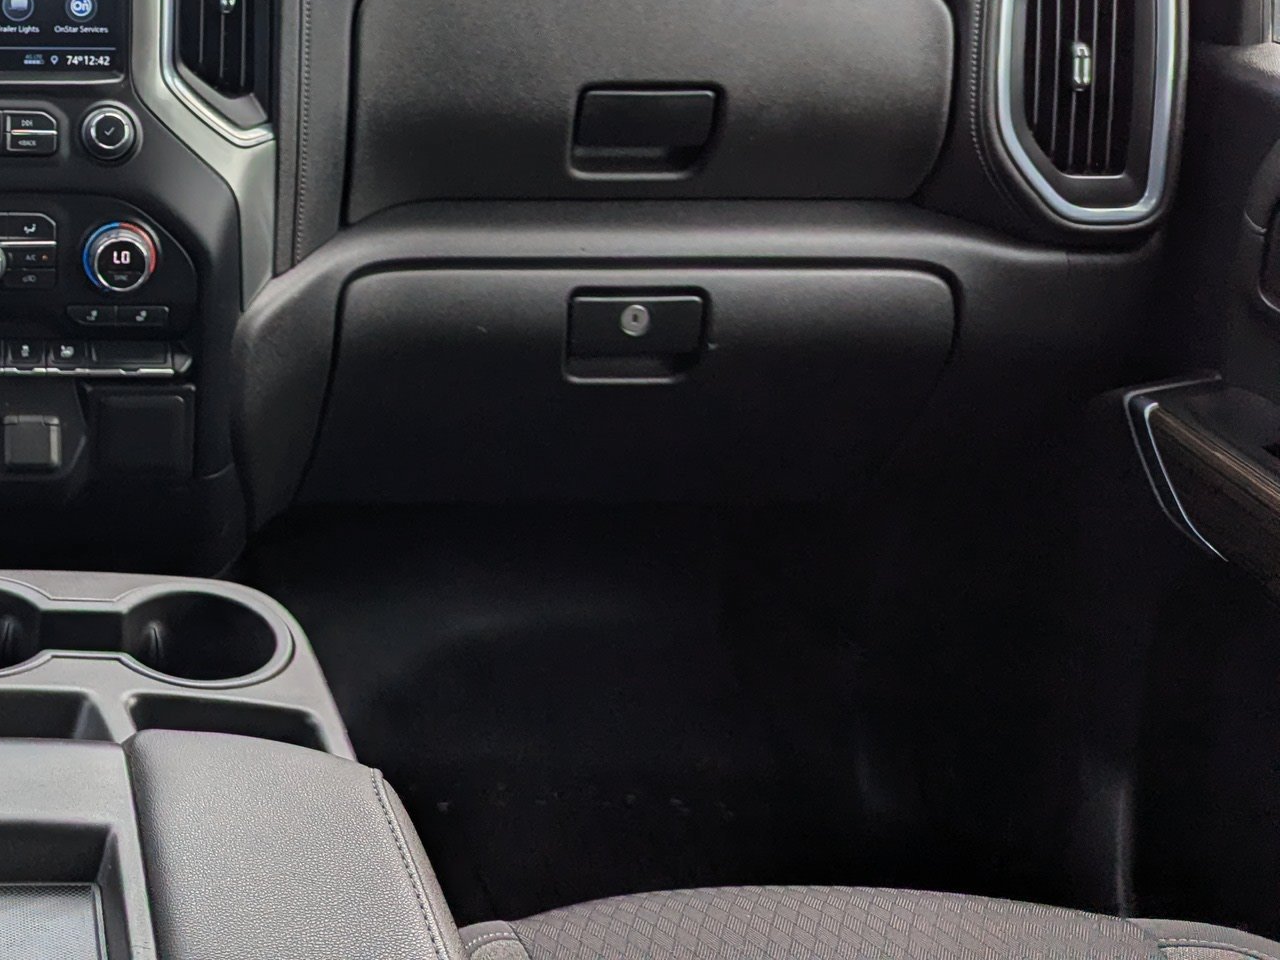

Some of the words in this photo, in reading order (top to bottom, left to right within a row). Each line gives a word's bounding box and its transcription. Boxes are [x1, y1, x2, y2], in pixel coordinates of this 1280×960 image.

[18, 25, 40, 35] Lights
[80, 26, 109, 34] Services
[84, 55, 110, 66] 12:42
[113, 250, 130, 264] LO
